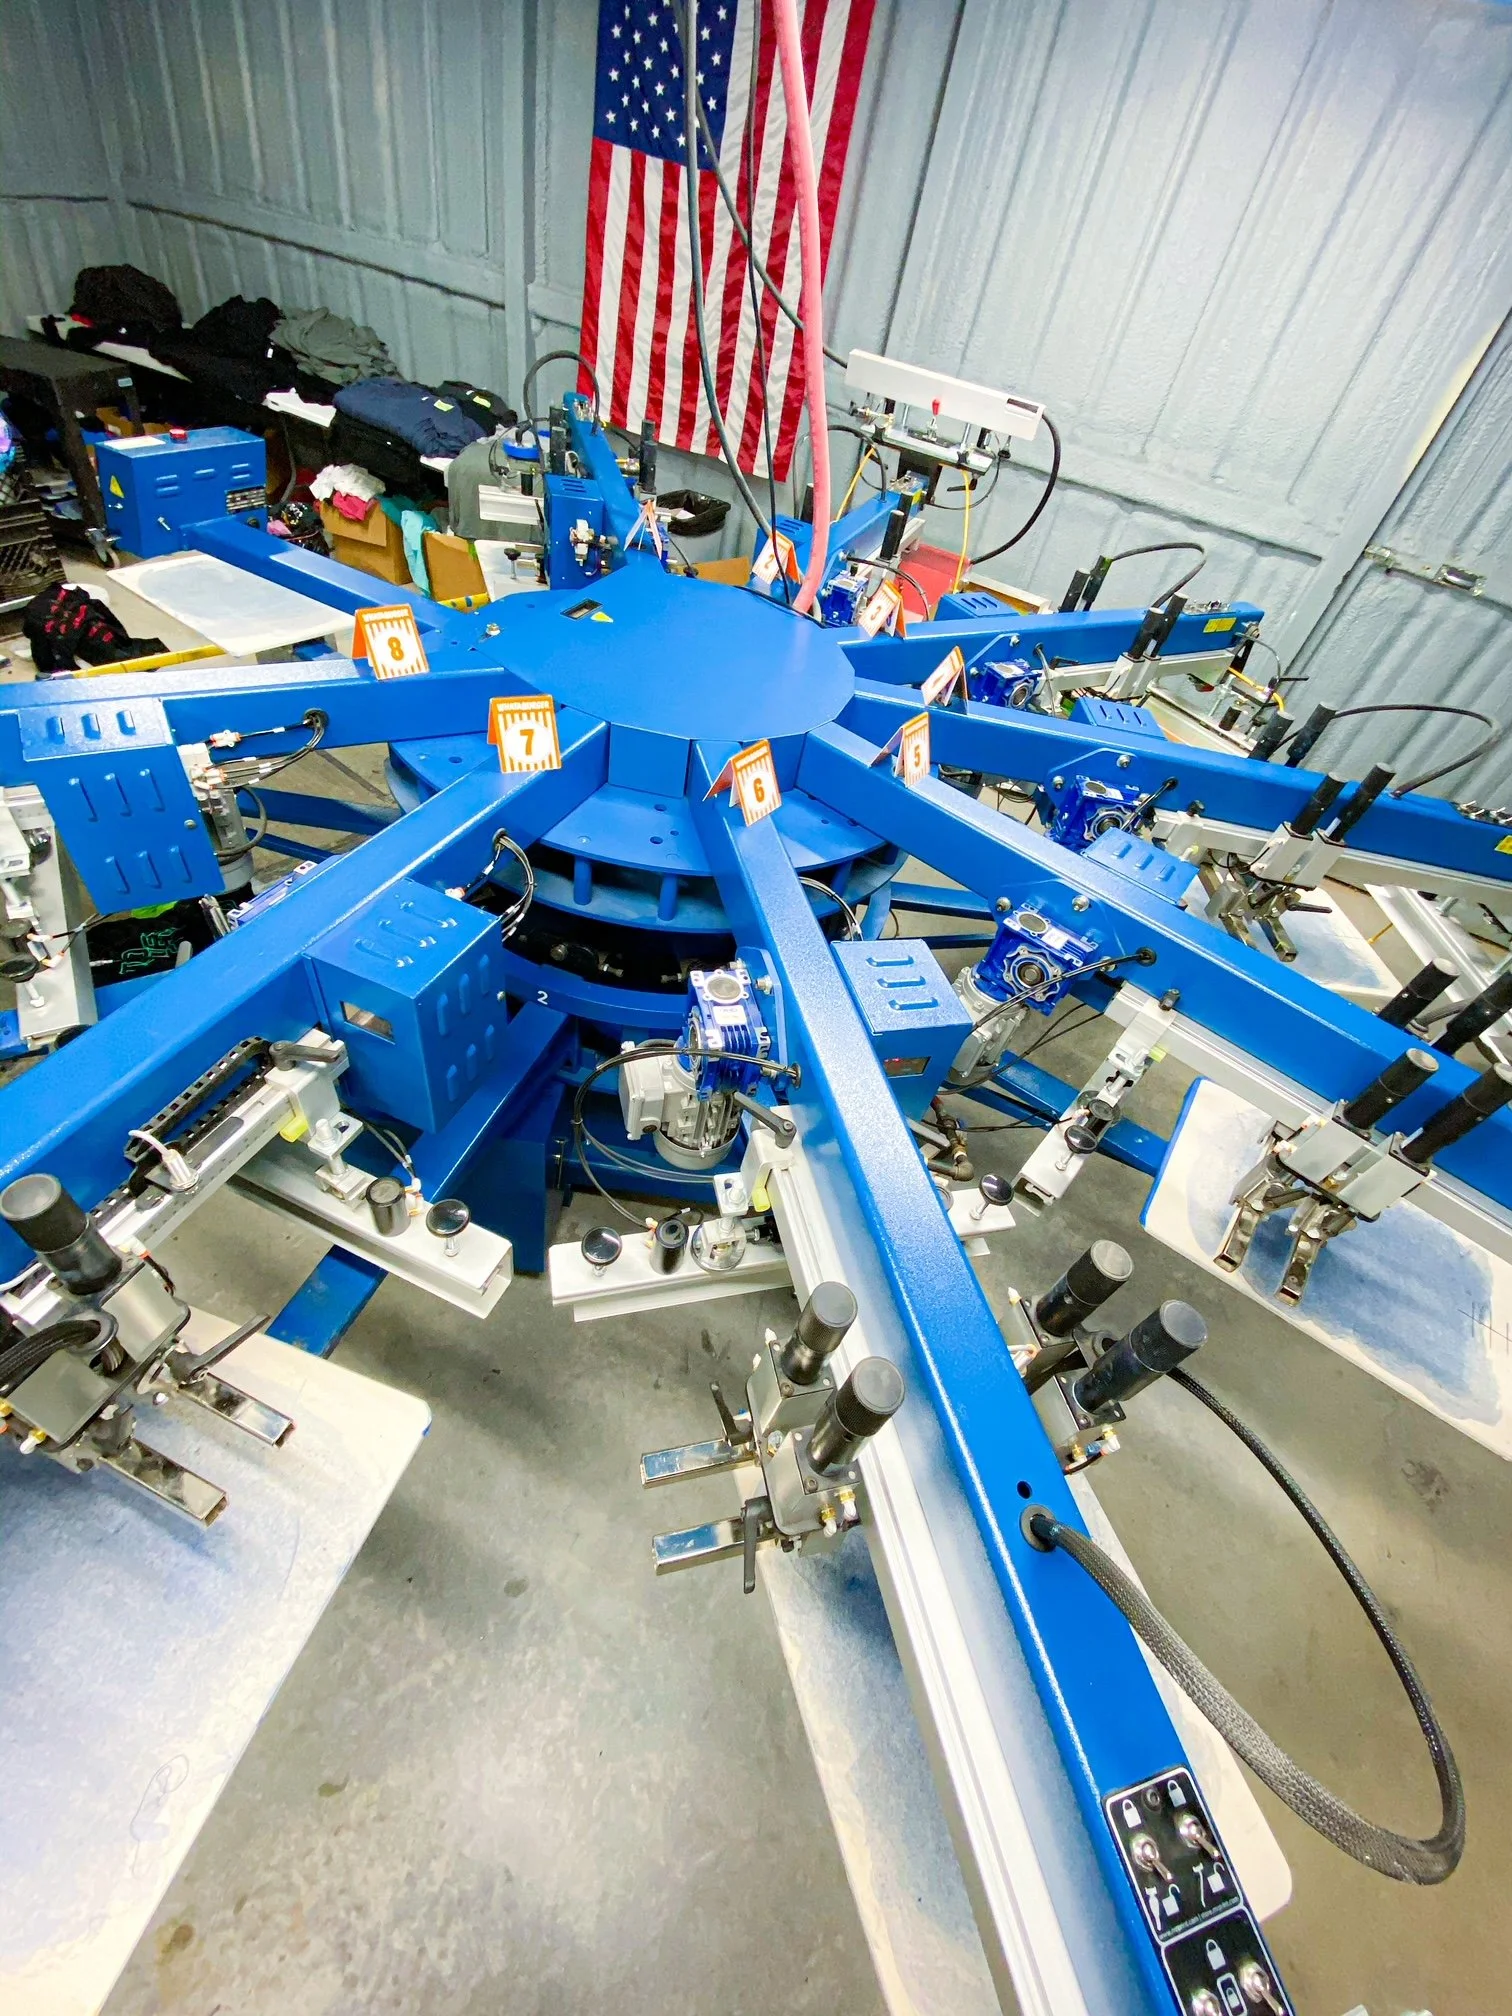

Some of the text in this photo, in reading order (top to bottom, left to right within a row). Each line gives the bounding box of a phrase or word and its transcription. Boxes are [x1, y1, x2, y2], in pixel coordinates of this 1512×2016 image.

[870, 605, 882, 621] 3
[387, 636, 405, 662] 8
[519, 728, 535, 756] 7
[914, 744, 921, 768] 5
[753, 777, 765, 803] 6
[537, 990, 549, 1005] 2
